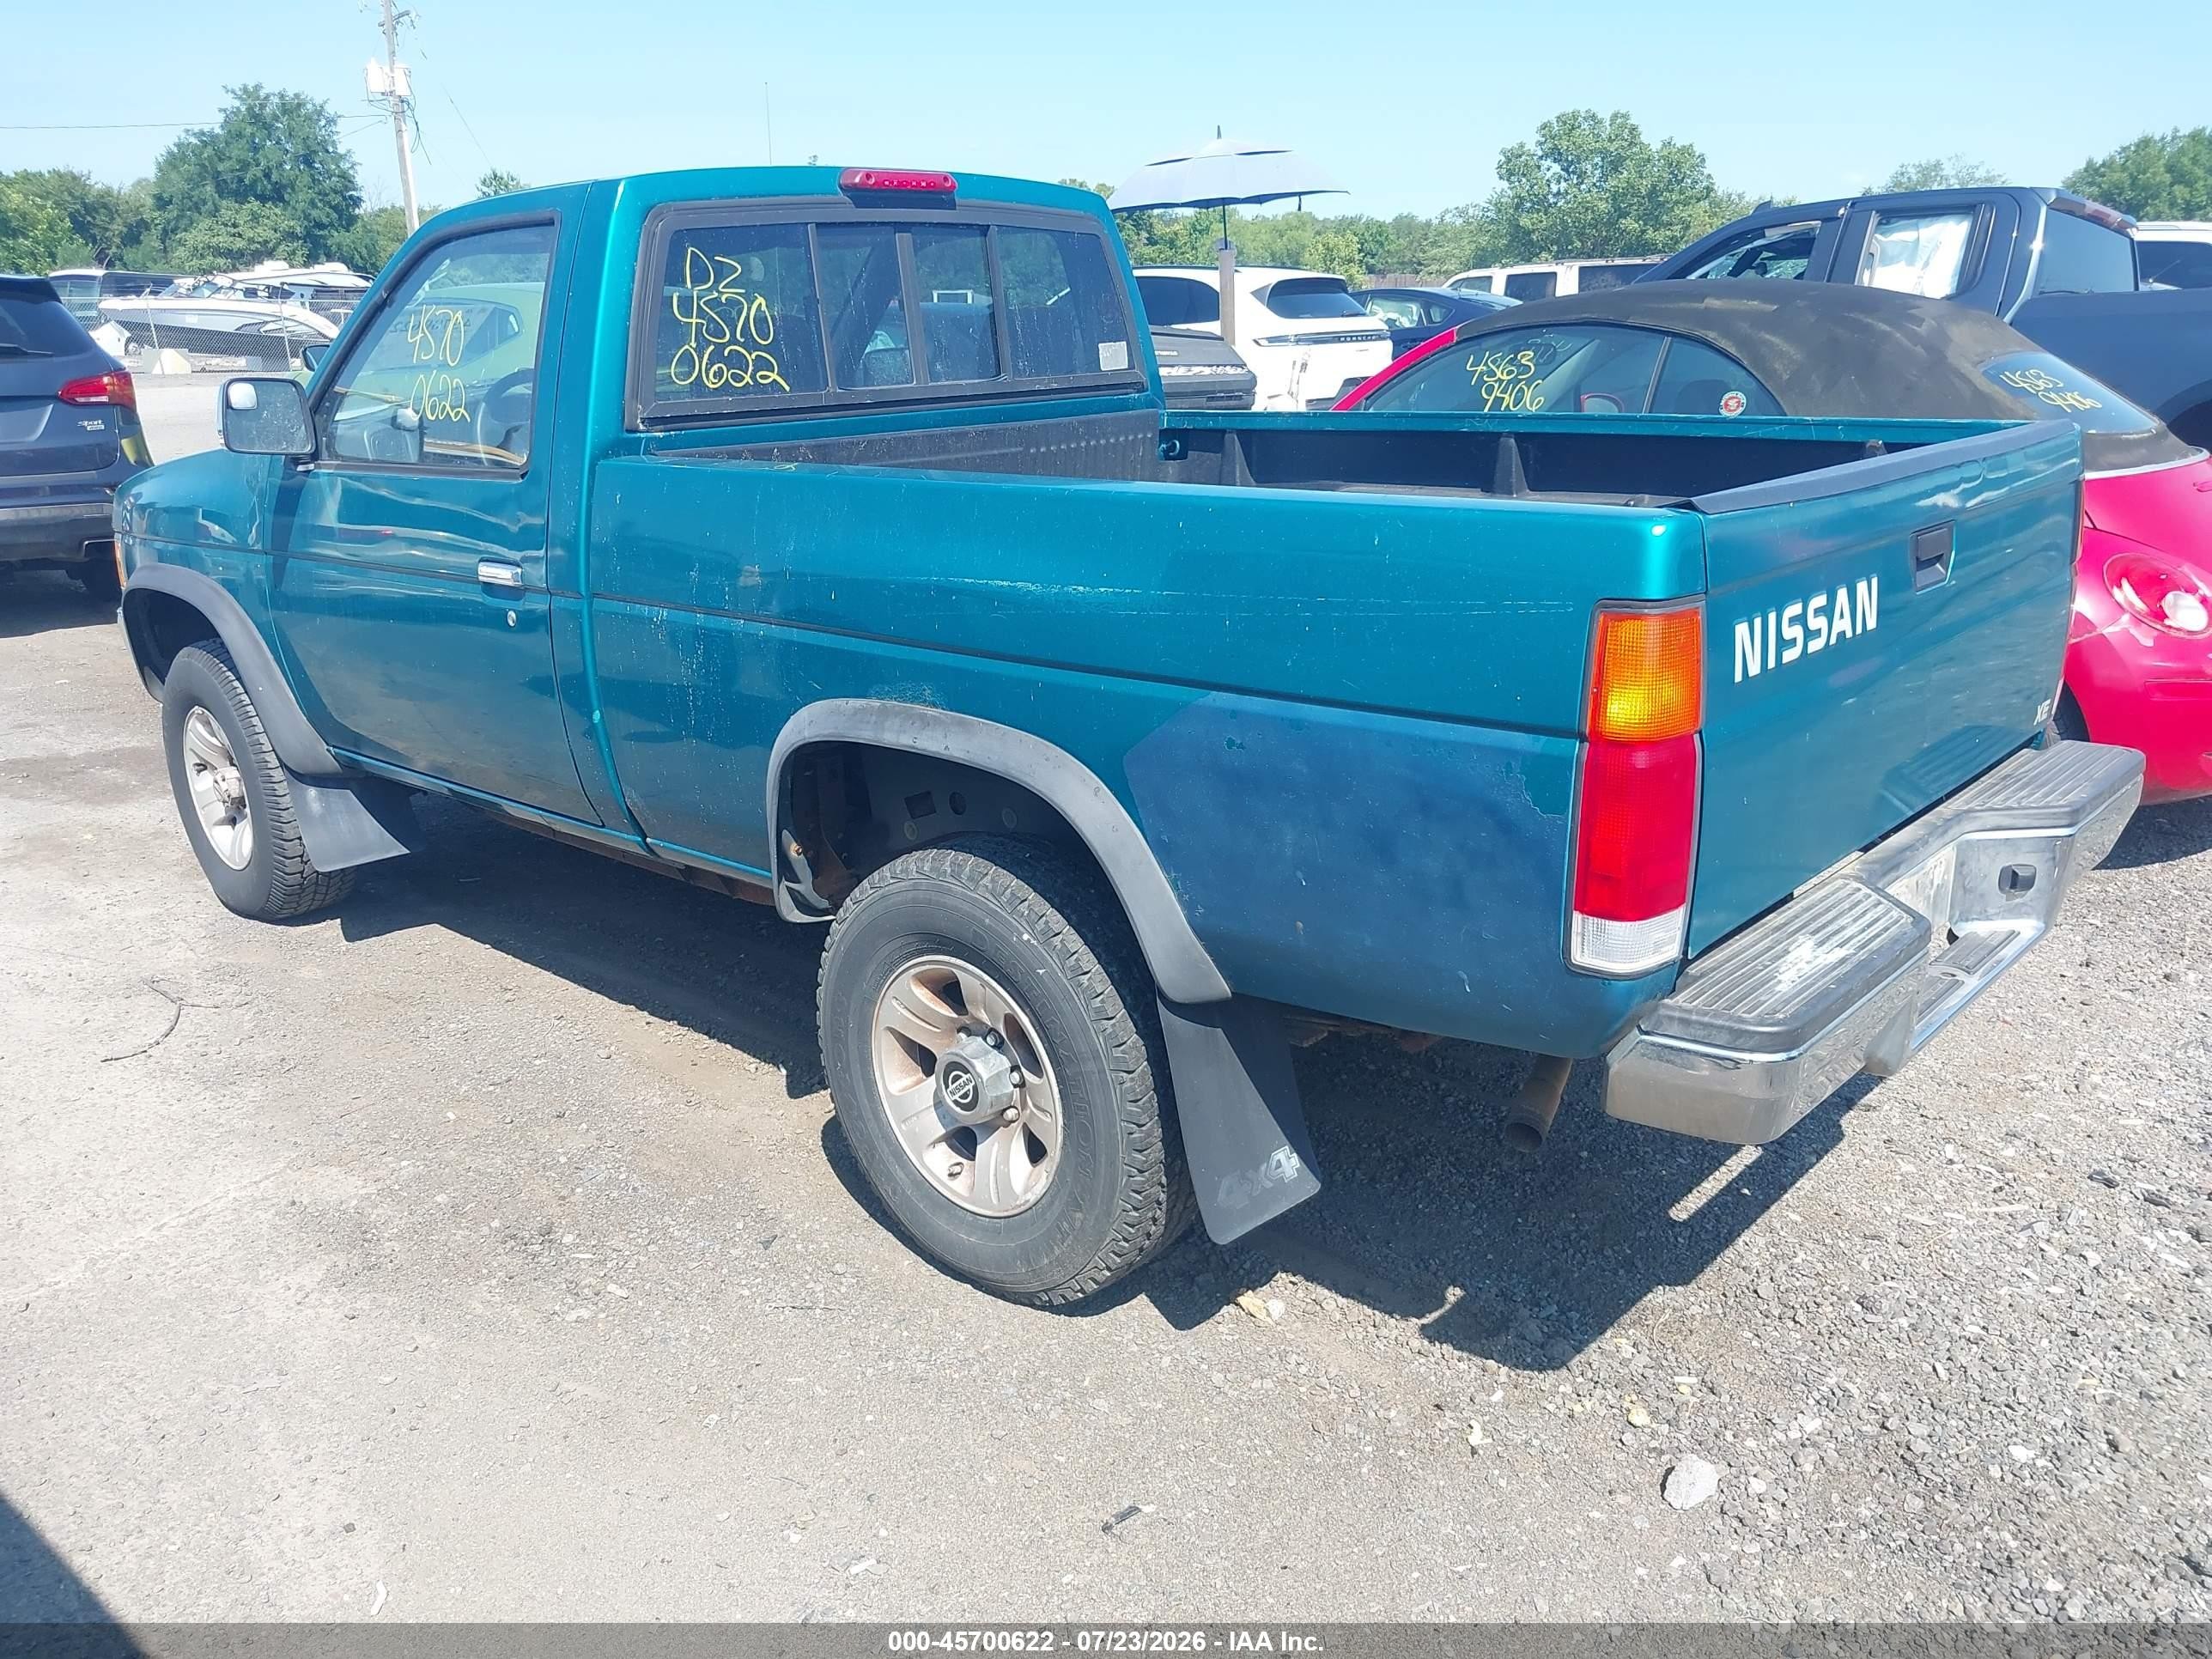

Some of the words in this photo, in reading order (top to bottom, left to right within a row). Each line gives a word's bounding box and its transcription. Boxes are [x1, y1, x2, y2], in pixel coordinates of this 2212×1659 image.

[407, 304, 465, 367] 4570
[672, 289, 774, 348] 4570
[671, 344, 791, 392] 0622
[1466, 350, 1535, 386] 4563
[1999, 368, 2064, 395] 4563
[410, 369, 471, 423] 0622
[1481, 379, 1545, 413] 9406
[1733, 574, 1879, 684] NISSAN
[2033, 698, 2051, 726] XE
[948, 1075, 973, 1097] NISSAN
